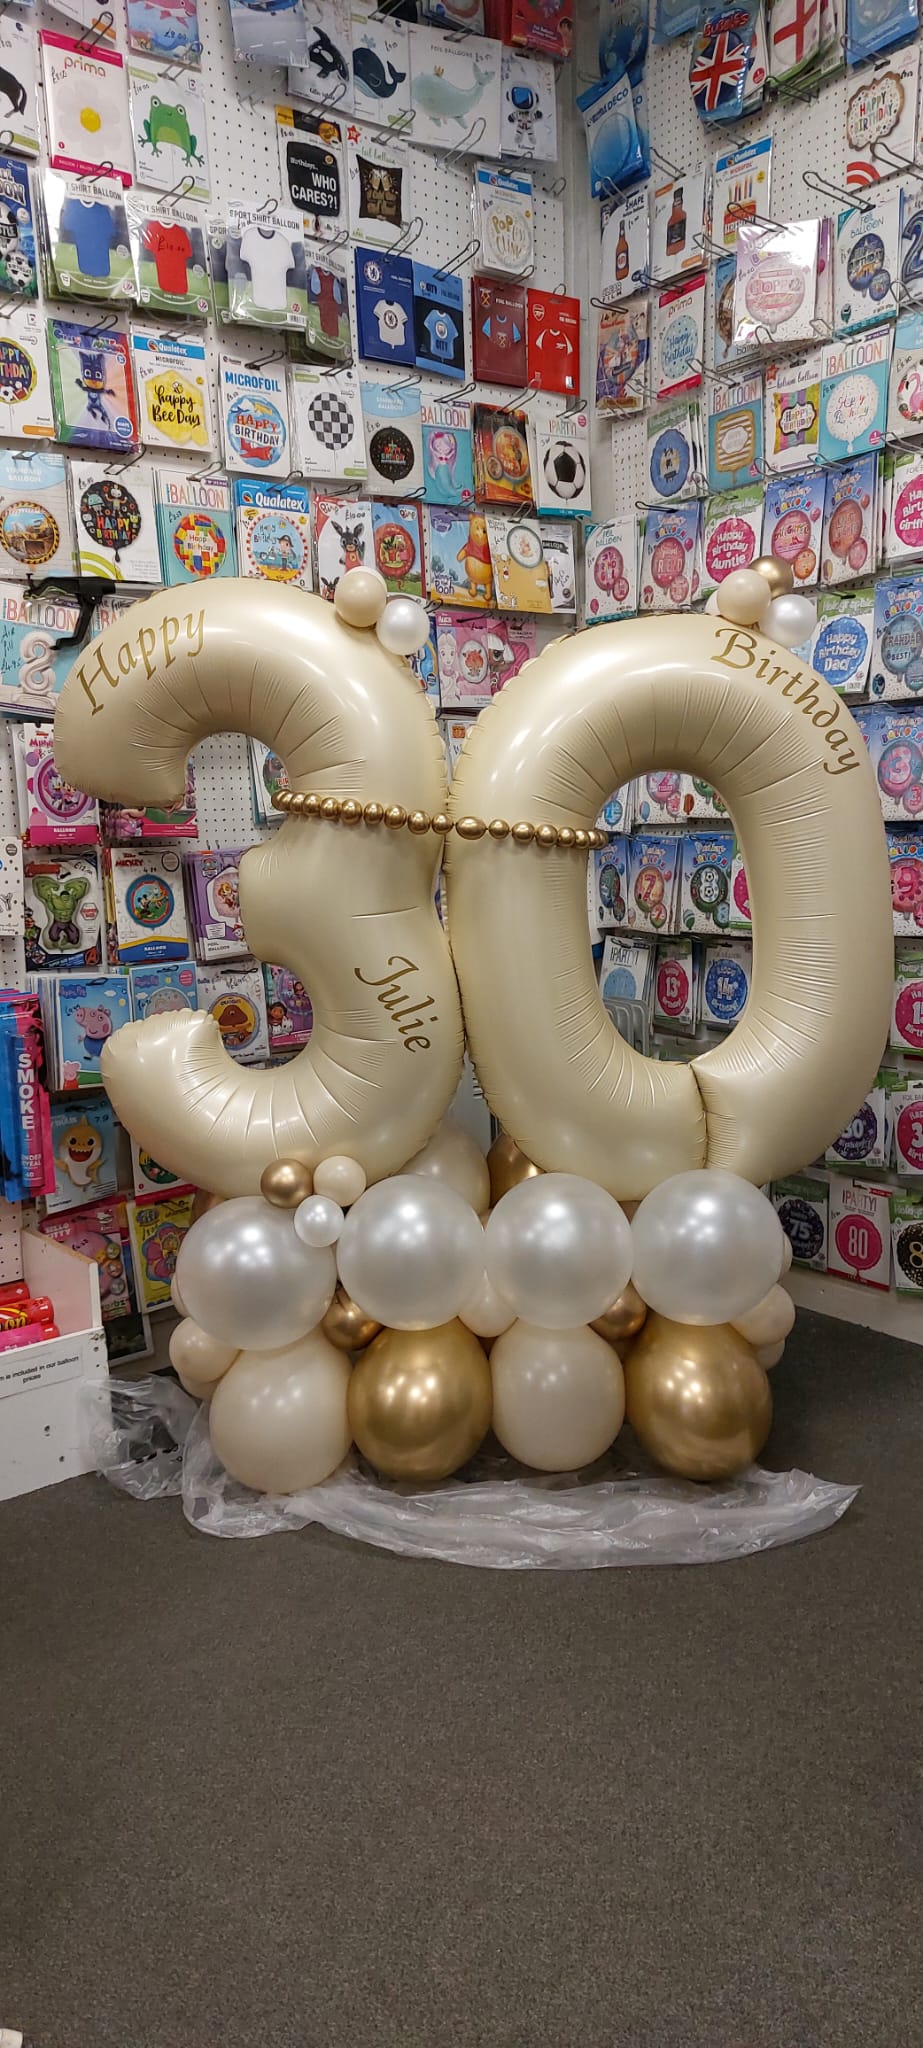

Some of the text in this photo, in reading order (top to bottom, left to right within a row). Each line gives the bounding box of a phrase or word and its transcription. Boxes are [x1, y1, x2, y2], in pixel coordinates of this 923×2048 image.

[704, 12, 750, 37] BUBBLES
[63, 55, 106, 78] prima
[860, 91, 886, 117] HAPPY
[853, 102, 894, 132] BIRTHDAY
[312, 172, 337, 191] WHO
[71, 184, 92, 196] SHIRT
[93, 188, 122, 201] BALLOON
[291, 185, 338, 210] CARES?!
[625, 194, 645, 211] SHAPE
[152, 205, 198, 223] SHIRT BALLOON
[229, 209, 300, 231] SPORT SHIRT BALLOON
[426, 283, 437, 295] CITY
[667, 297, 693, 318] prima
[158, 343, 188, 356] Qualatex
[436, 339, 448, 352] CITY
[225, 371, 281, 392] MICROFOIL
[155, 384, 195, 411] happy
[152, 405, 201, 426] Bee Day
[236, 415, 278, 433] HAPPY
[235, 425, 279, 446] BIRTHDAY
[255, 493, 304, 512] Qualatex
[97, 515, 130, 530] HAPPY
[712, 542, 748, 558] Birthday
[711, 555, 746, 570] Auntie
[826, 633, 858, 648] Happy
[77, 609, 205, 716] Happy
[818, 646, 861, 660] Birthday
[824, 658, 849, 672] Dad
[711, 628, 861, 775] Birthday
[354, 955, 438, 1053] Julie
[17, 1053, 35, 1130] SMOKE
[48, 1228, 72, 1239] ITTY
[789, 1218, 813, 1239] 75
[848, 1226, 869, 1260] 80
[12, 1366, 38, 1377] included
[57, 1356, 79, 1366] balloon
